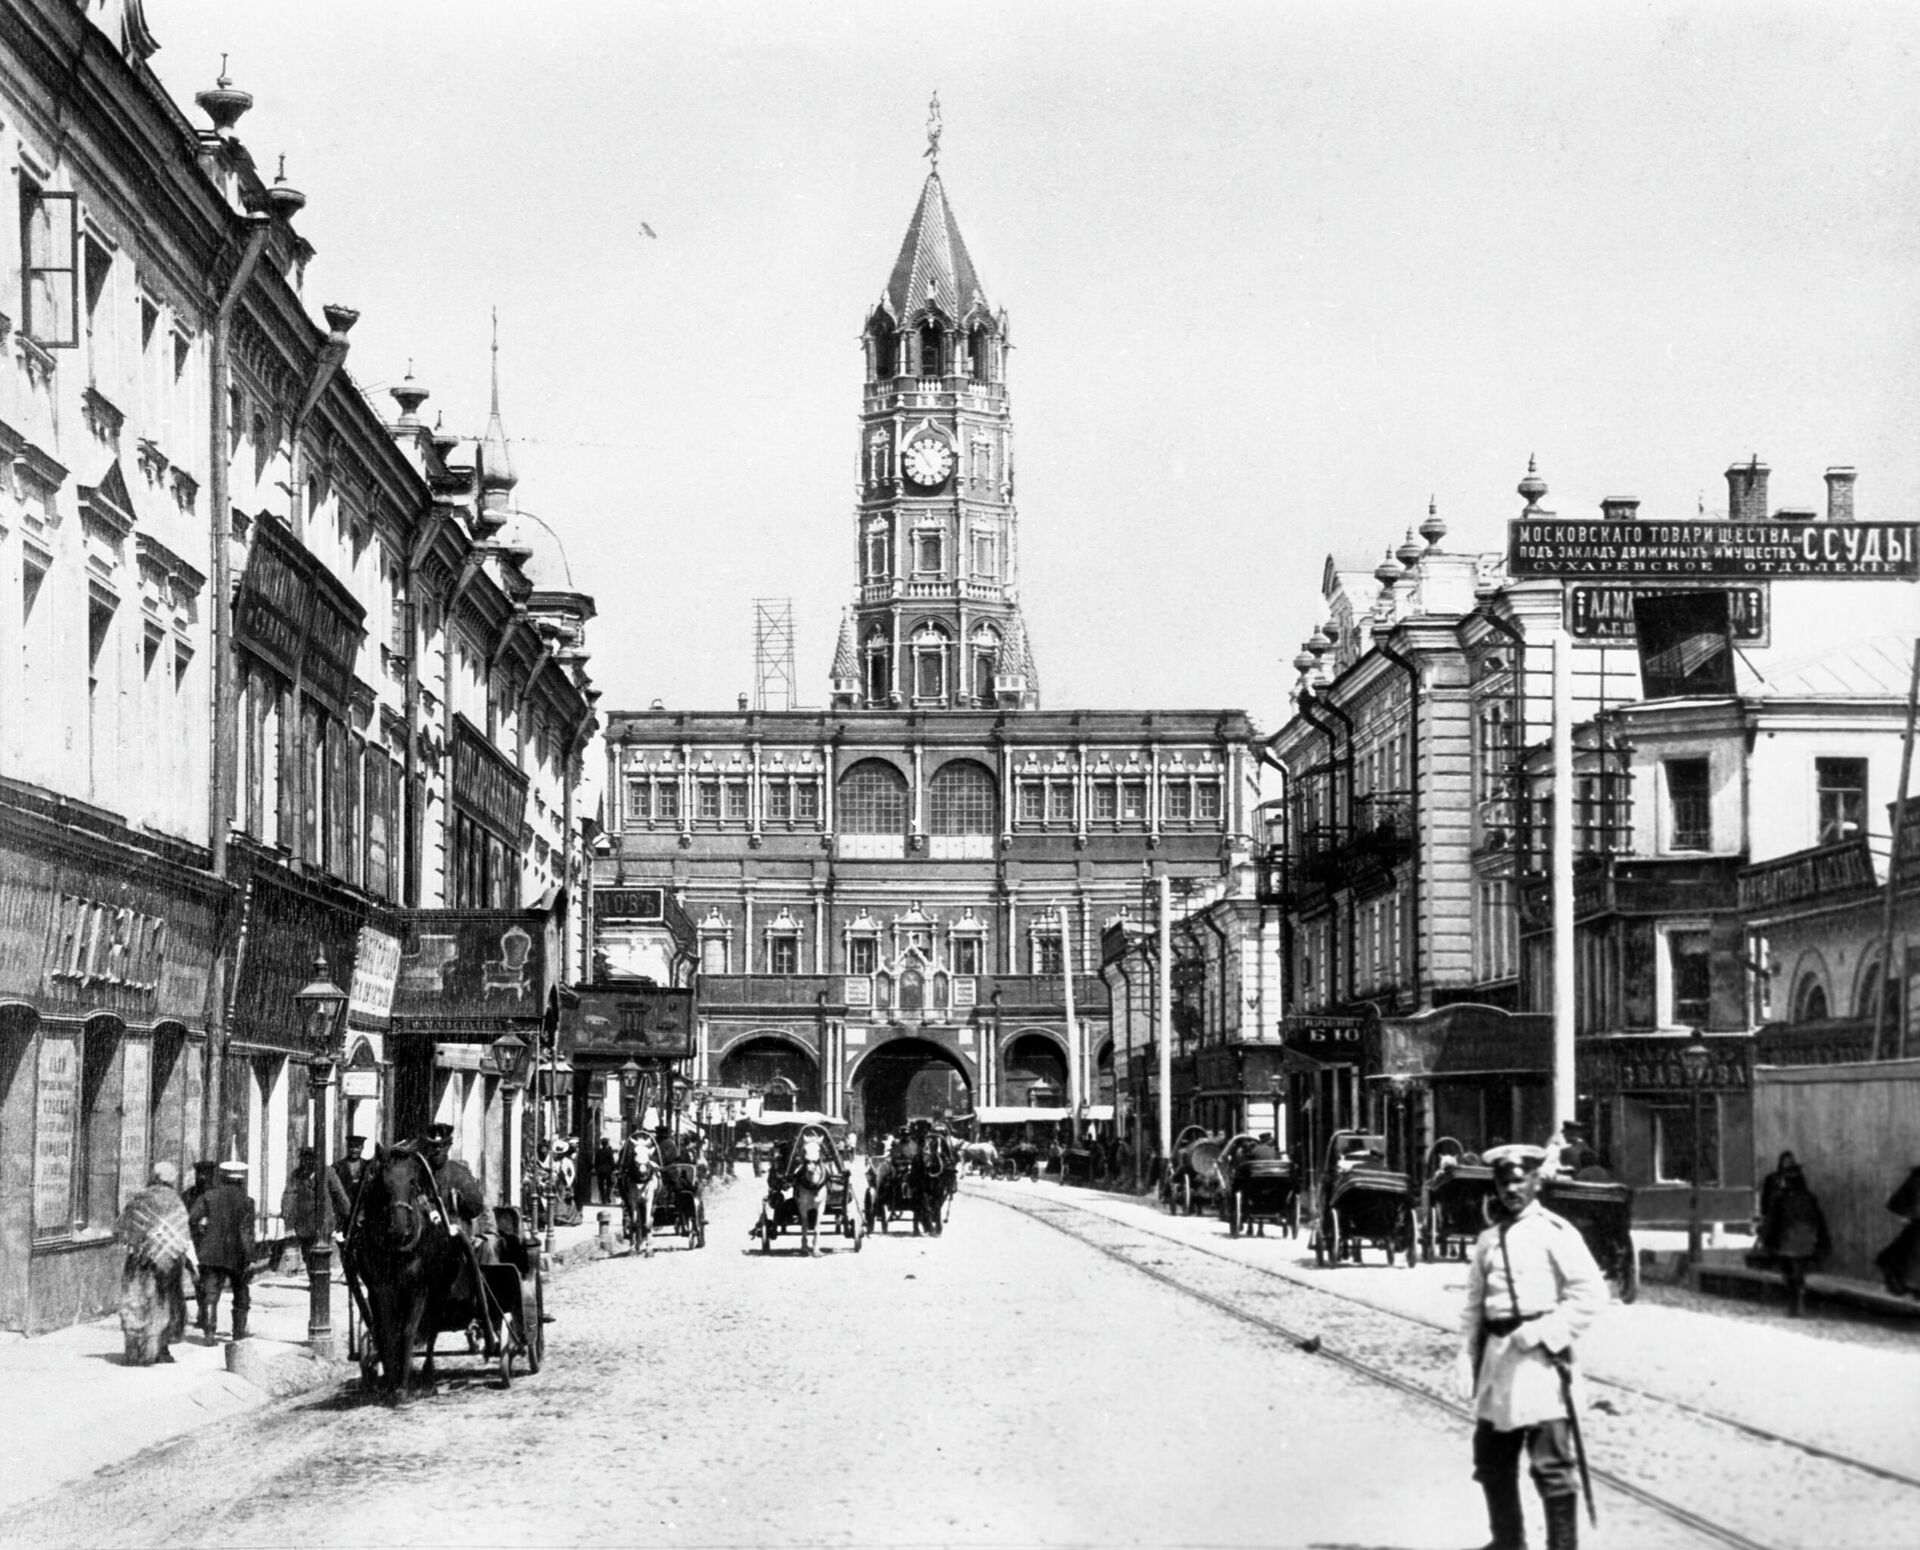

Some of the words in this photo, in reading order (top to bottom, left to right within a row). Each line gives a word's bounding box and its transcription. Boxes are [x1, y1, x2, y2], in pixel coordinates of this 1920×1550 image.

[1519, 526, 1642, 543] МОСКОВСКАГО
[1650, 526, 1791, 544] ТОВАРИЩЕСТВА
[1802, 526, 1913, 563] ССУДЫ
[1519, 546, 1553, 560] ПОДЪ
[1558, 546, 1616, 560] ЗАКЛАДЪ
[1620, 546, 1708, 560] ДВИЖИМЫХЪ
[1714, 546, 1797, 560] ИМУЩЕСТВЪ
[1532, 561, 1714, 571] СУХАРЕВСКОЕ
